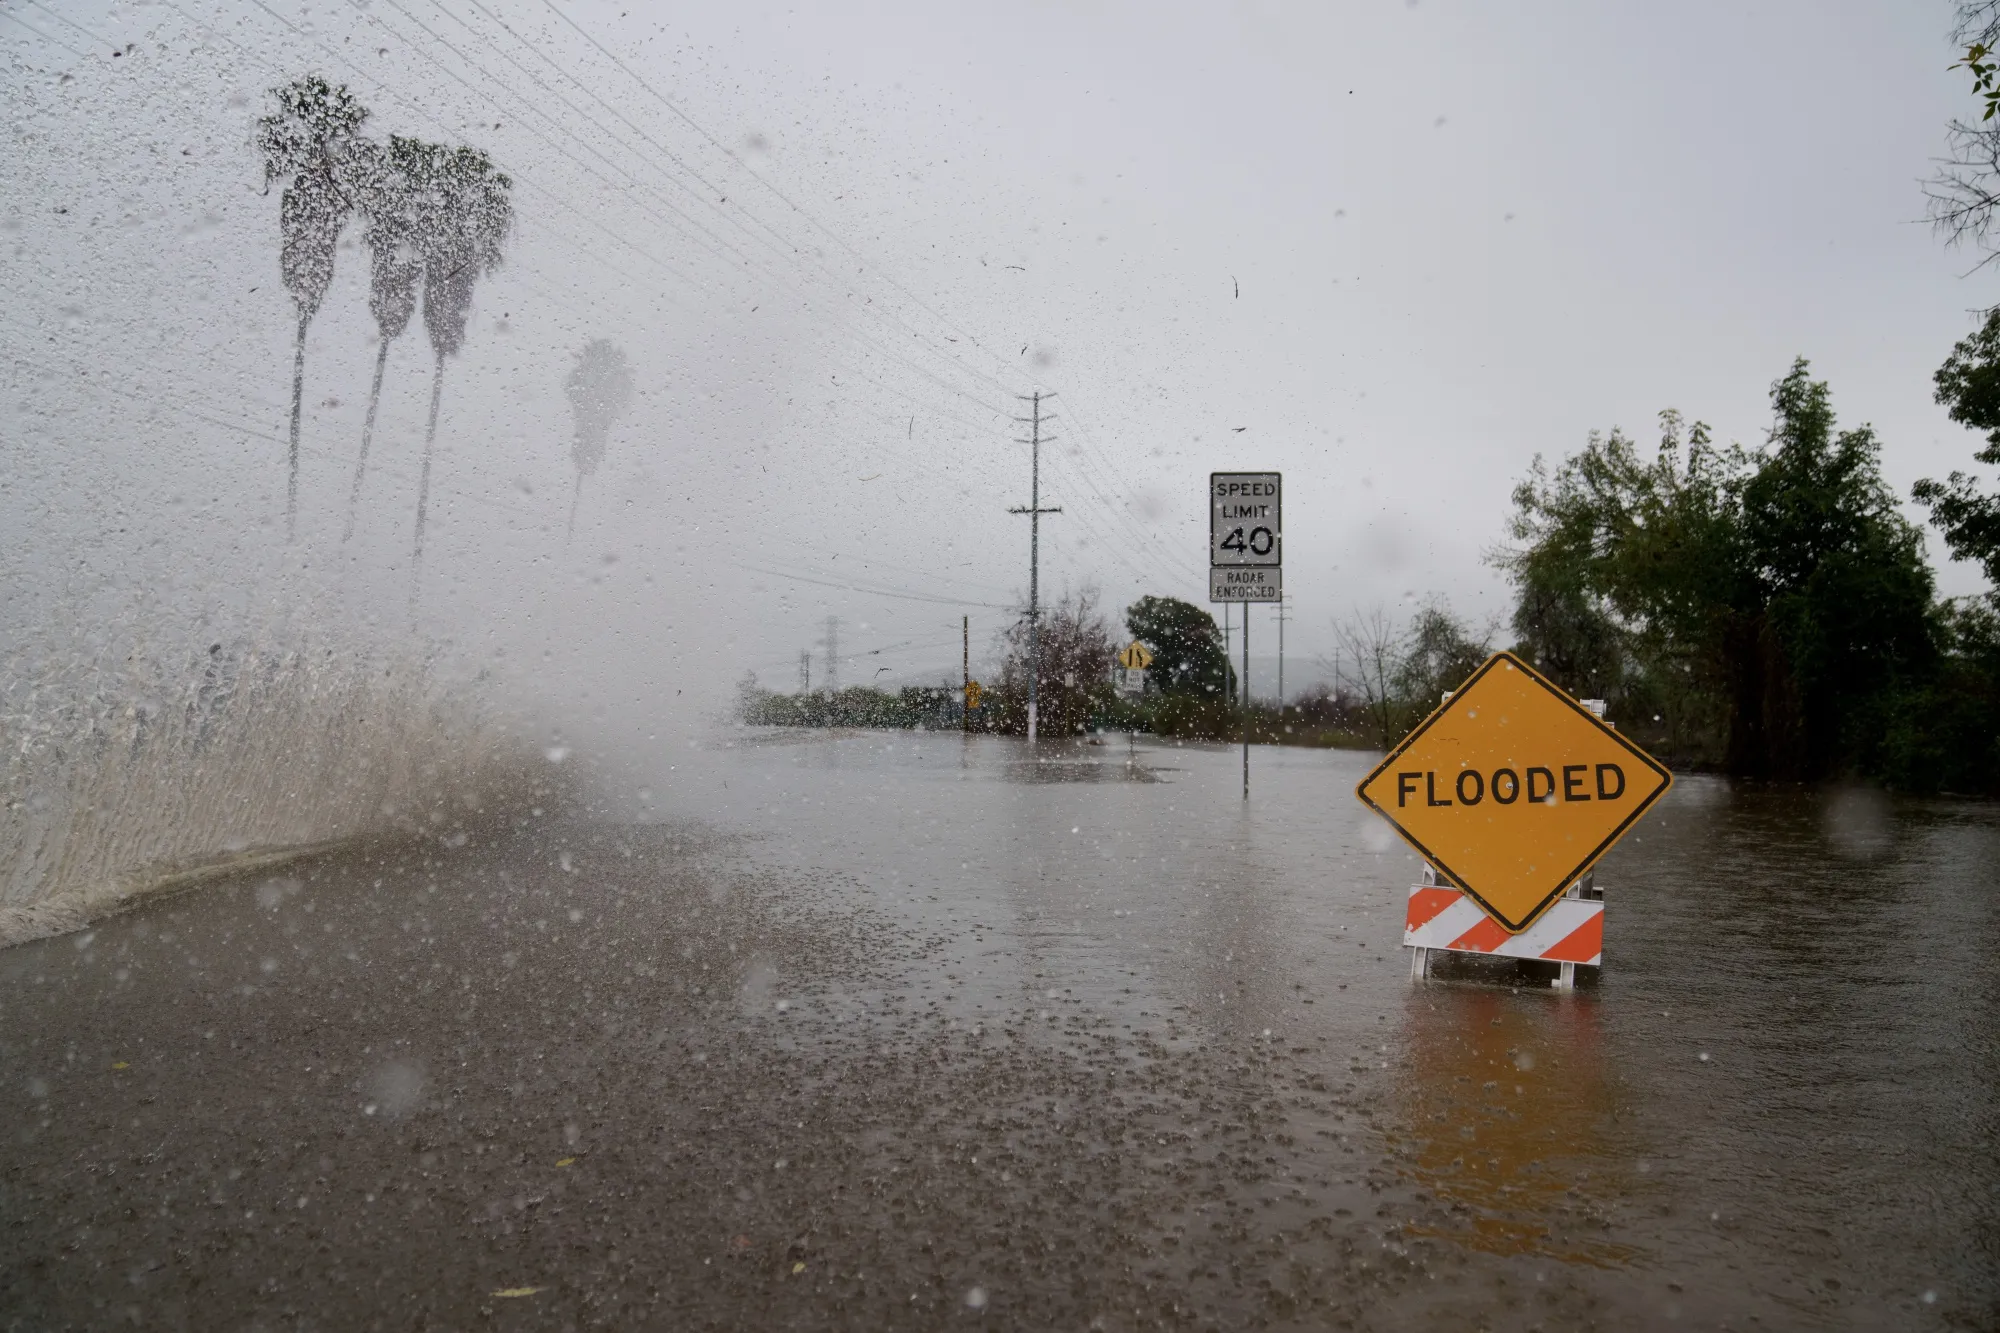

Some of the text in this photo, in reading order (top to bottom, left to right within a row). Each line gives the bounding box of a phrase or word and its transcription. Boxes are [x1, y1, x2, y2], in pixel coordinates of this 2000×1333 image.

[1217, 483, 1275, 497] SPEED
[1222, 505, 1269, 518] LIMIT
[1220, 526, 1274, 556] 40
[1227, 572, 1265, 584] RADAR
[1216, 586, 1275, 598] ENFORCED
[1397, 763, 1625, 807] FLOODED
